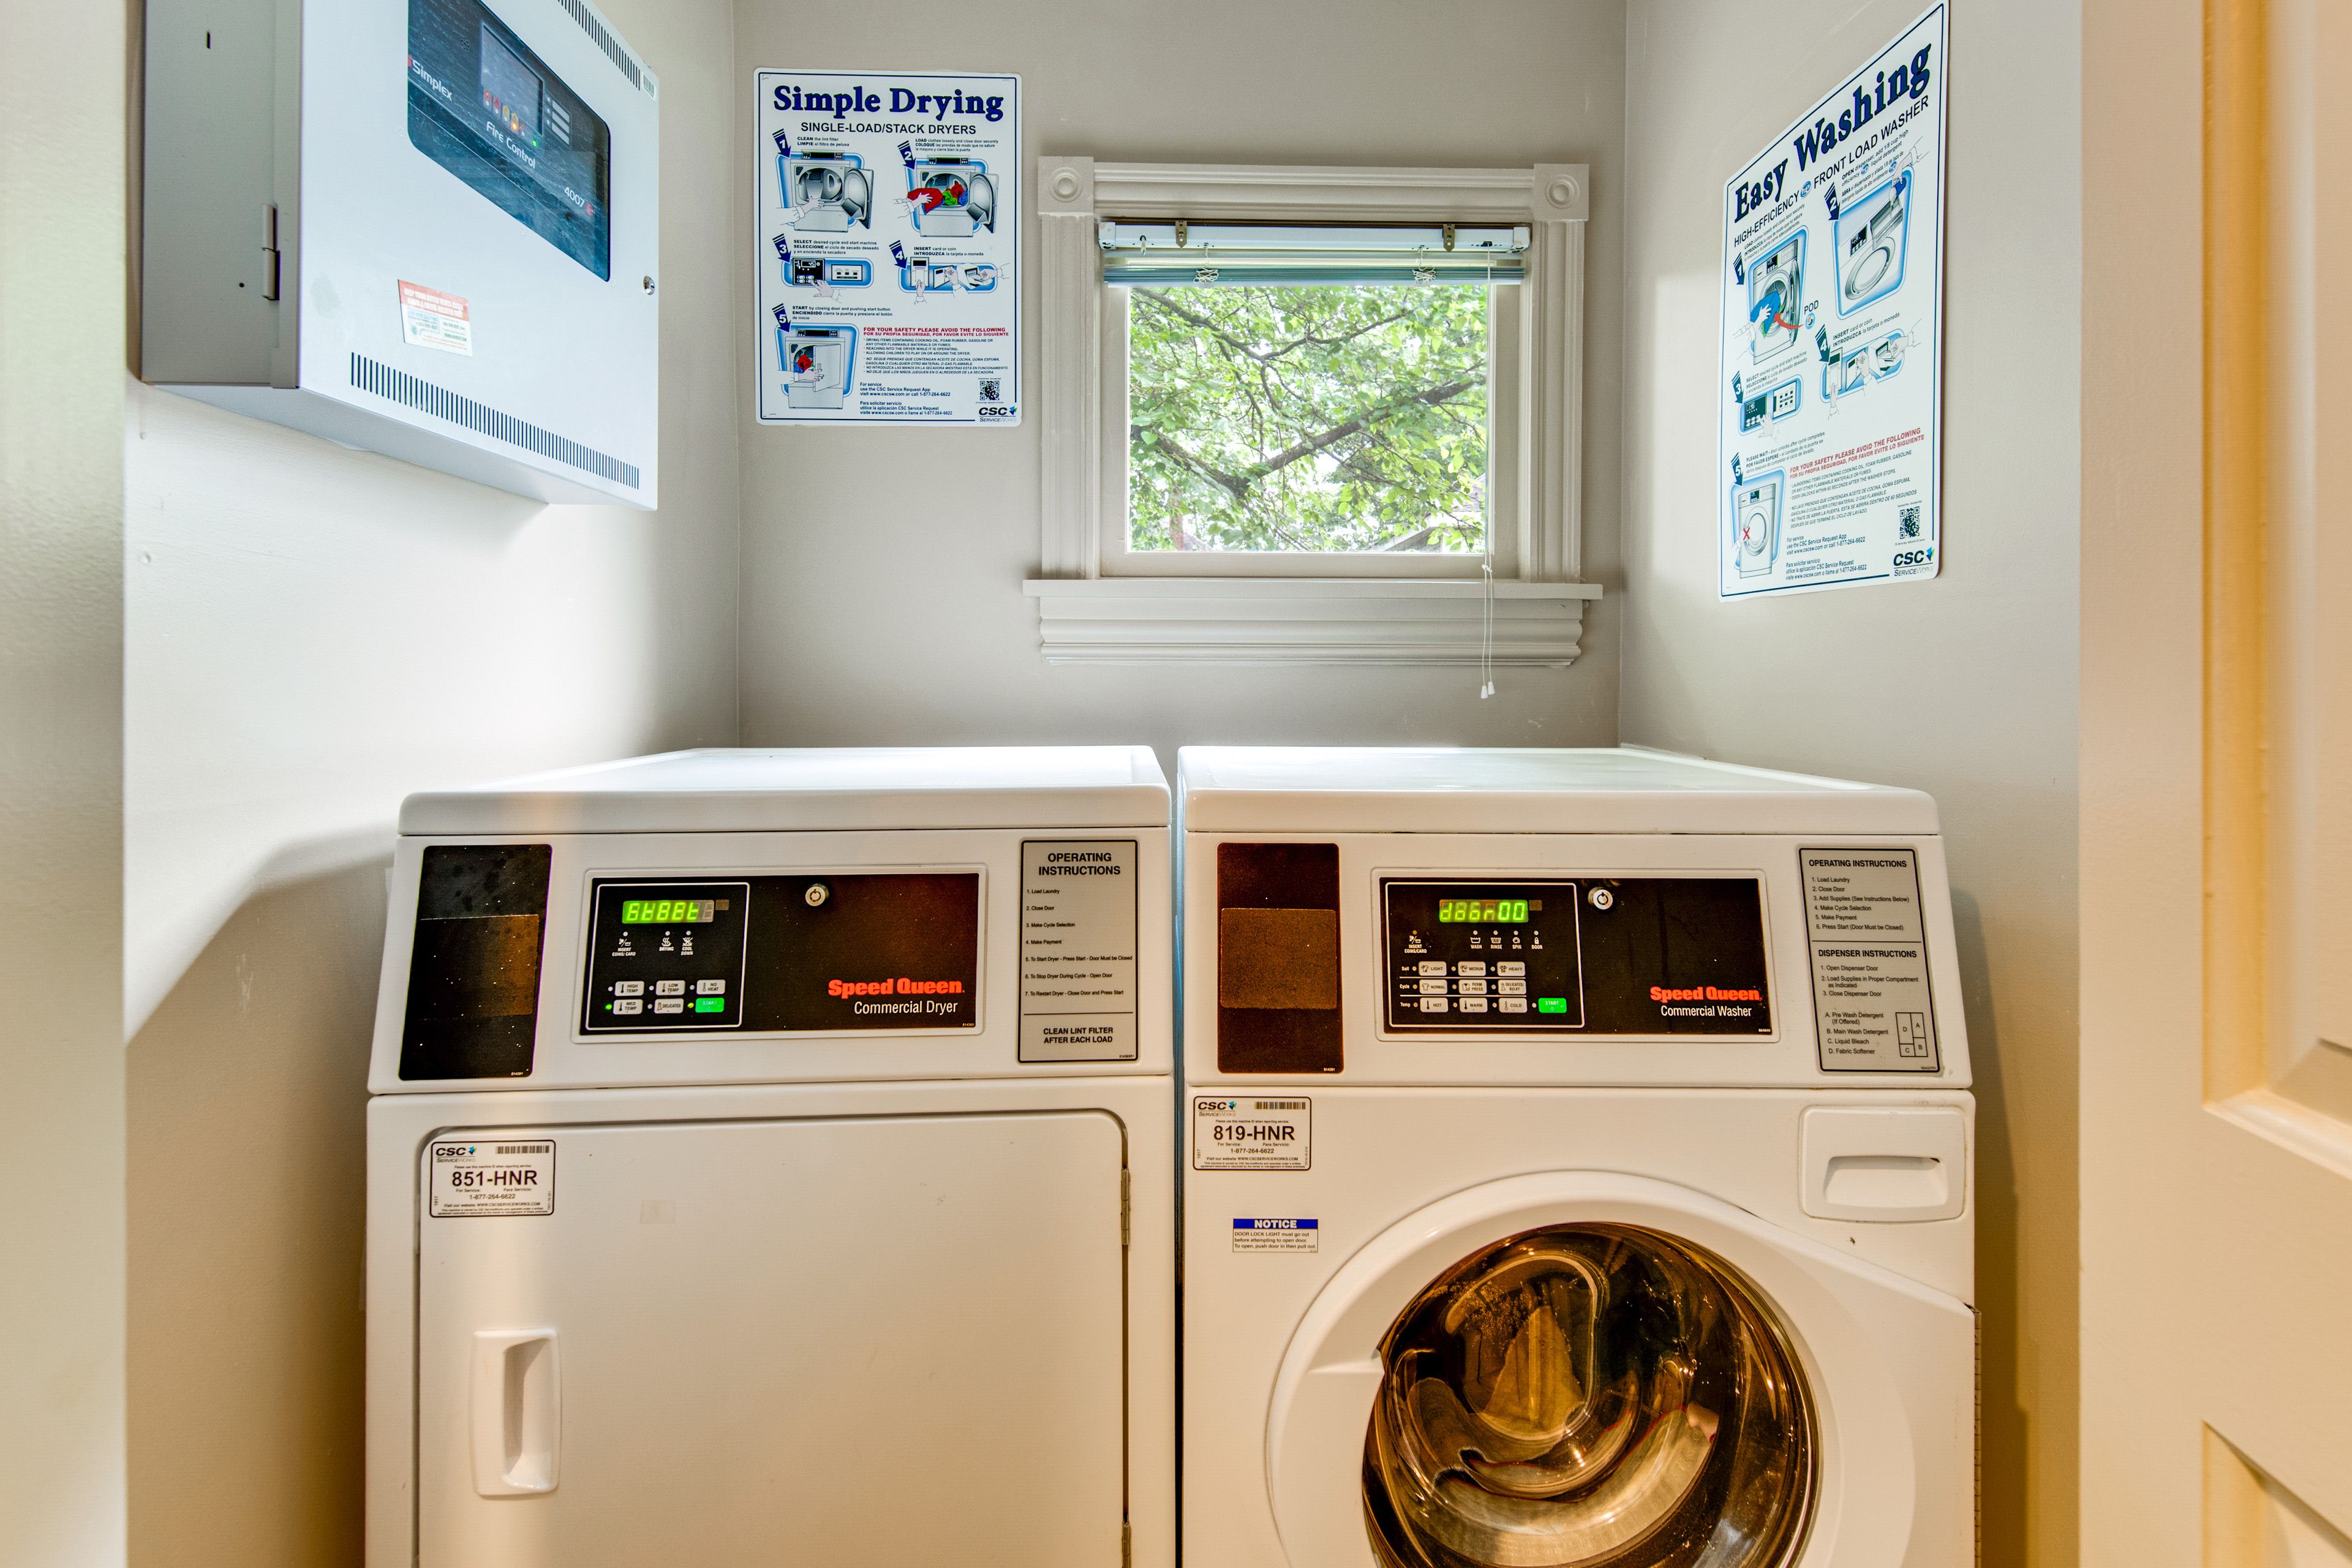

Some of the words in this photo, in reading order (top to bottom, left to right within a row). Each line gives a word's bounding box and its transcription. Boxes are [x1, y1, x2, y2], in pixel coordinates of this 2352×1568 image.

[413, 59, 452, 102] Simplex
[773, 85, 880, 119] Simple
[889, 88, 1004, 122] Drying
[801, 122, 924, 133] SINGLE-LOAD/STACK
[928, 124, 976, 134] DRYERS
[1735, 158, 1788, 223] Easy
[1794, 43, 1932, 172] Washing
[486, 121, 504, 143] Fire
[507, 137, 536, 169] Control
[780, 140, 786, 148] 1
[905, 151, 911, 160] 2
[1735, 190, 1800, 247] HIGH-EFFICIENCY
[1814, 157, 1846, 189] FRONT
[1849, 136, 1878, 164] LOAD
[1881, 95, 1928, 140] WASHER
[564, 186, 585, 208] 4007
[1830, 197, 1837, 211] 2
[780, 245, 787, 254] 3
[897, 251, 903, 260] 4
[1737, 264, 1743, 277] 1
[1804, 300, 1819, 315] POD
[779, 314, 786, 323] 5
[1833, 328, 1849, 339] INSERT
[1736, 383, 1741, 394] 3
[978, 407, 1008, 417] CSC
[1800, 461, 1813, 470] YOUR
[1814, 455, 1833, 466] SAFETY
[1835, 448, 1855, 460] PLEASE
[1856, 443, 1872, 453] AVOID
[1874, 439, 1885, 447] THE
[1886, 428, 1920, 444] FOLLOWING
[1735, 464, 1741, 476] 5
[1893, 550, 1924, 566] CSC
[1047, 852, 1111, 862] OPERATING
[1038, 865, 1120, 875] INSTRUCTIONS
[828, 978, 894, 999] Speed
[1650, 986, 1704, 1003] Speed
[854, 1000, 922, 1014] Commercial
[926, 1000, 958, 1015] Dryer
[1661, 1005, 1715, 1016] Commercial
[1717, 1005, 1752, 1016] Washer
[1198, 1102, 1227, 1110] CSC
[1213, 1125, 1295, 1140] 819-HNR
[435, 1147, 466, 1156] CSC
[452, 1170, 537, 1186] 851-HNR
[1254, 1219, 1297, 1228] NOTICE
